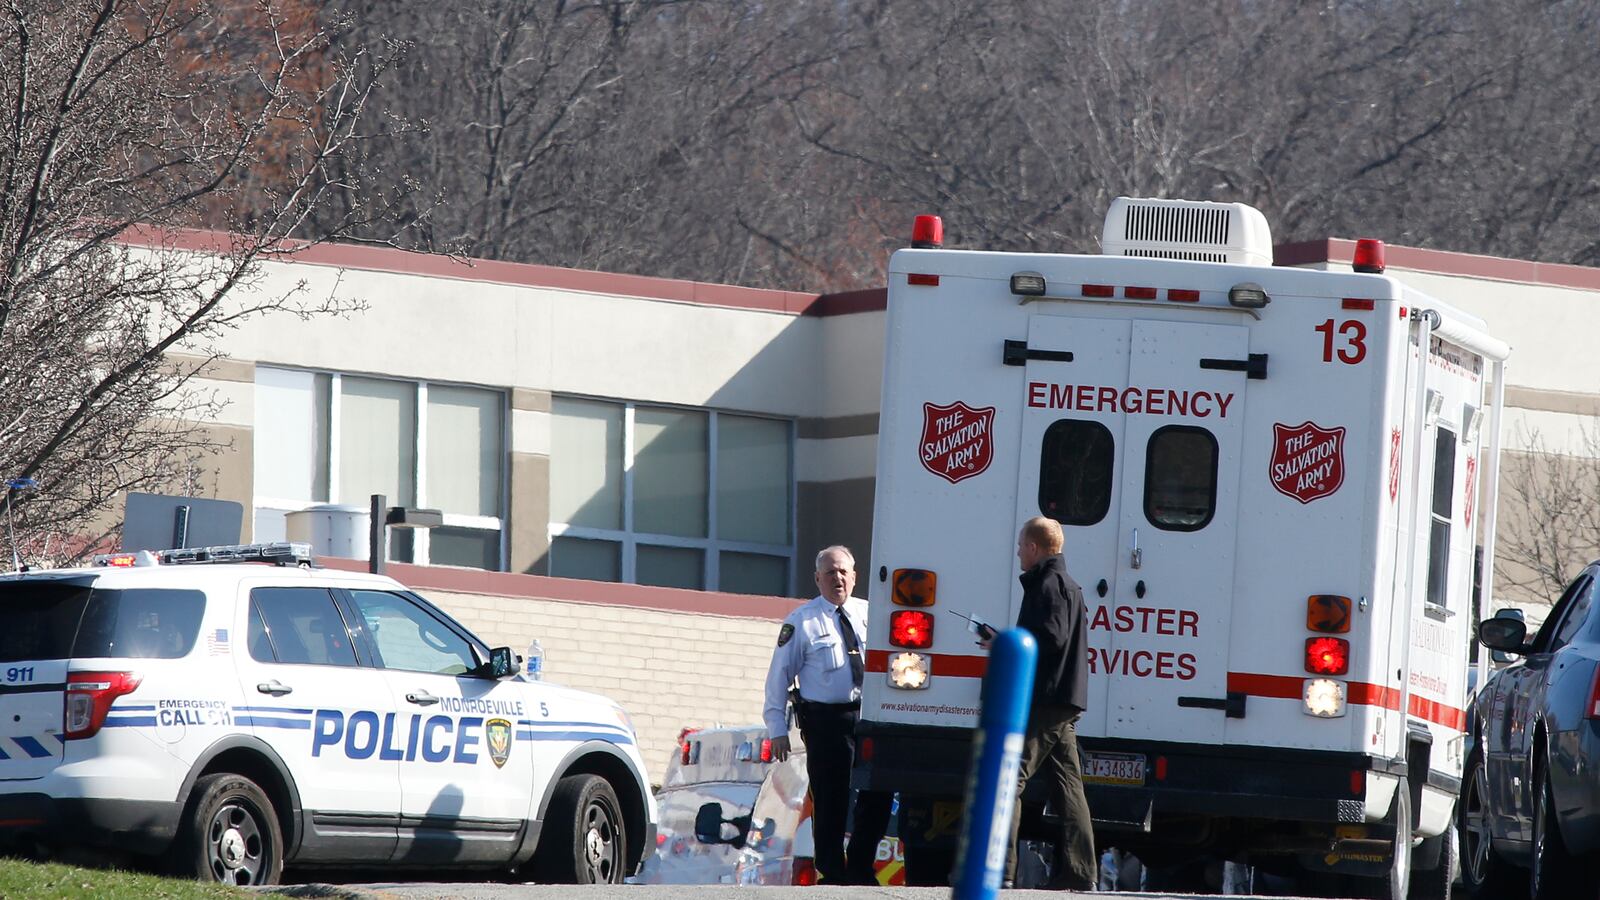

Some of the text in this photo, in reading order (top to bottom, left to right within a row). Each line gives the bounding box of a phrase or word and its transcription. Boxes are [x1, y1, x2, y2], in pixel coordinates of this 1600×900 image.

[1315, 318, 1367, 364] 13
[1027, 382, 1235, 418] EMERGENCY
[925, 415, 987, 461] SALVATION
[936, 411, 964, 435] THE
[945, 439, 983, 473] ARMY
[1275, 435, 1337, 481] SALVATION
[1285, 431, 1314, 455] THE
[1296, 458, 1334, 493] ARMY
[1084, 605, 1199, 637] ASTER
[7, 667, 34, 682] 911
[159, 700, 226, 710] EMERGENCY
[160, 709, 205, 726] CALL
[440, 697, 549, 717] MONROEVILLE 5
[311, 709, 484, 764] POLICE
